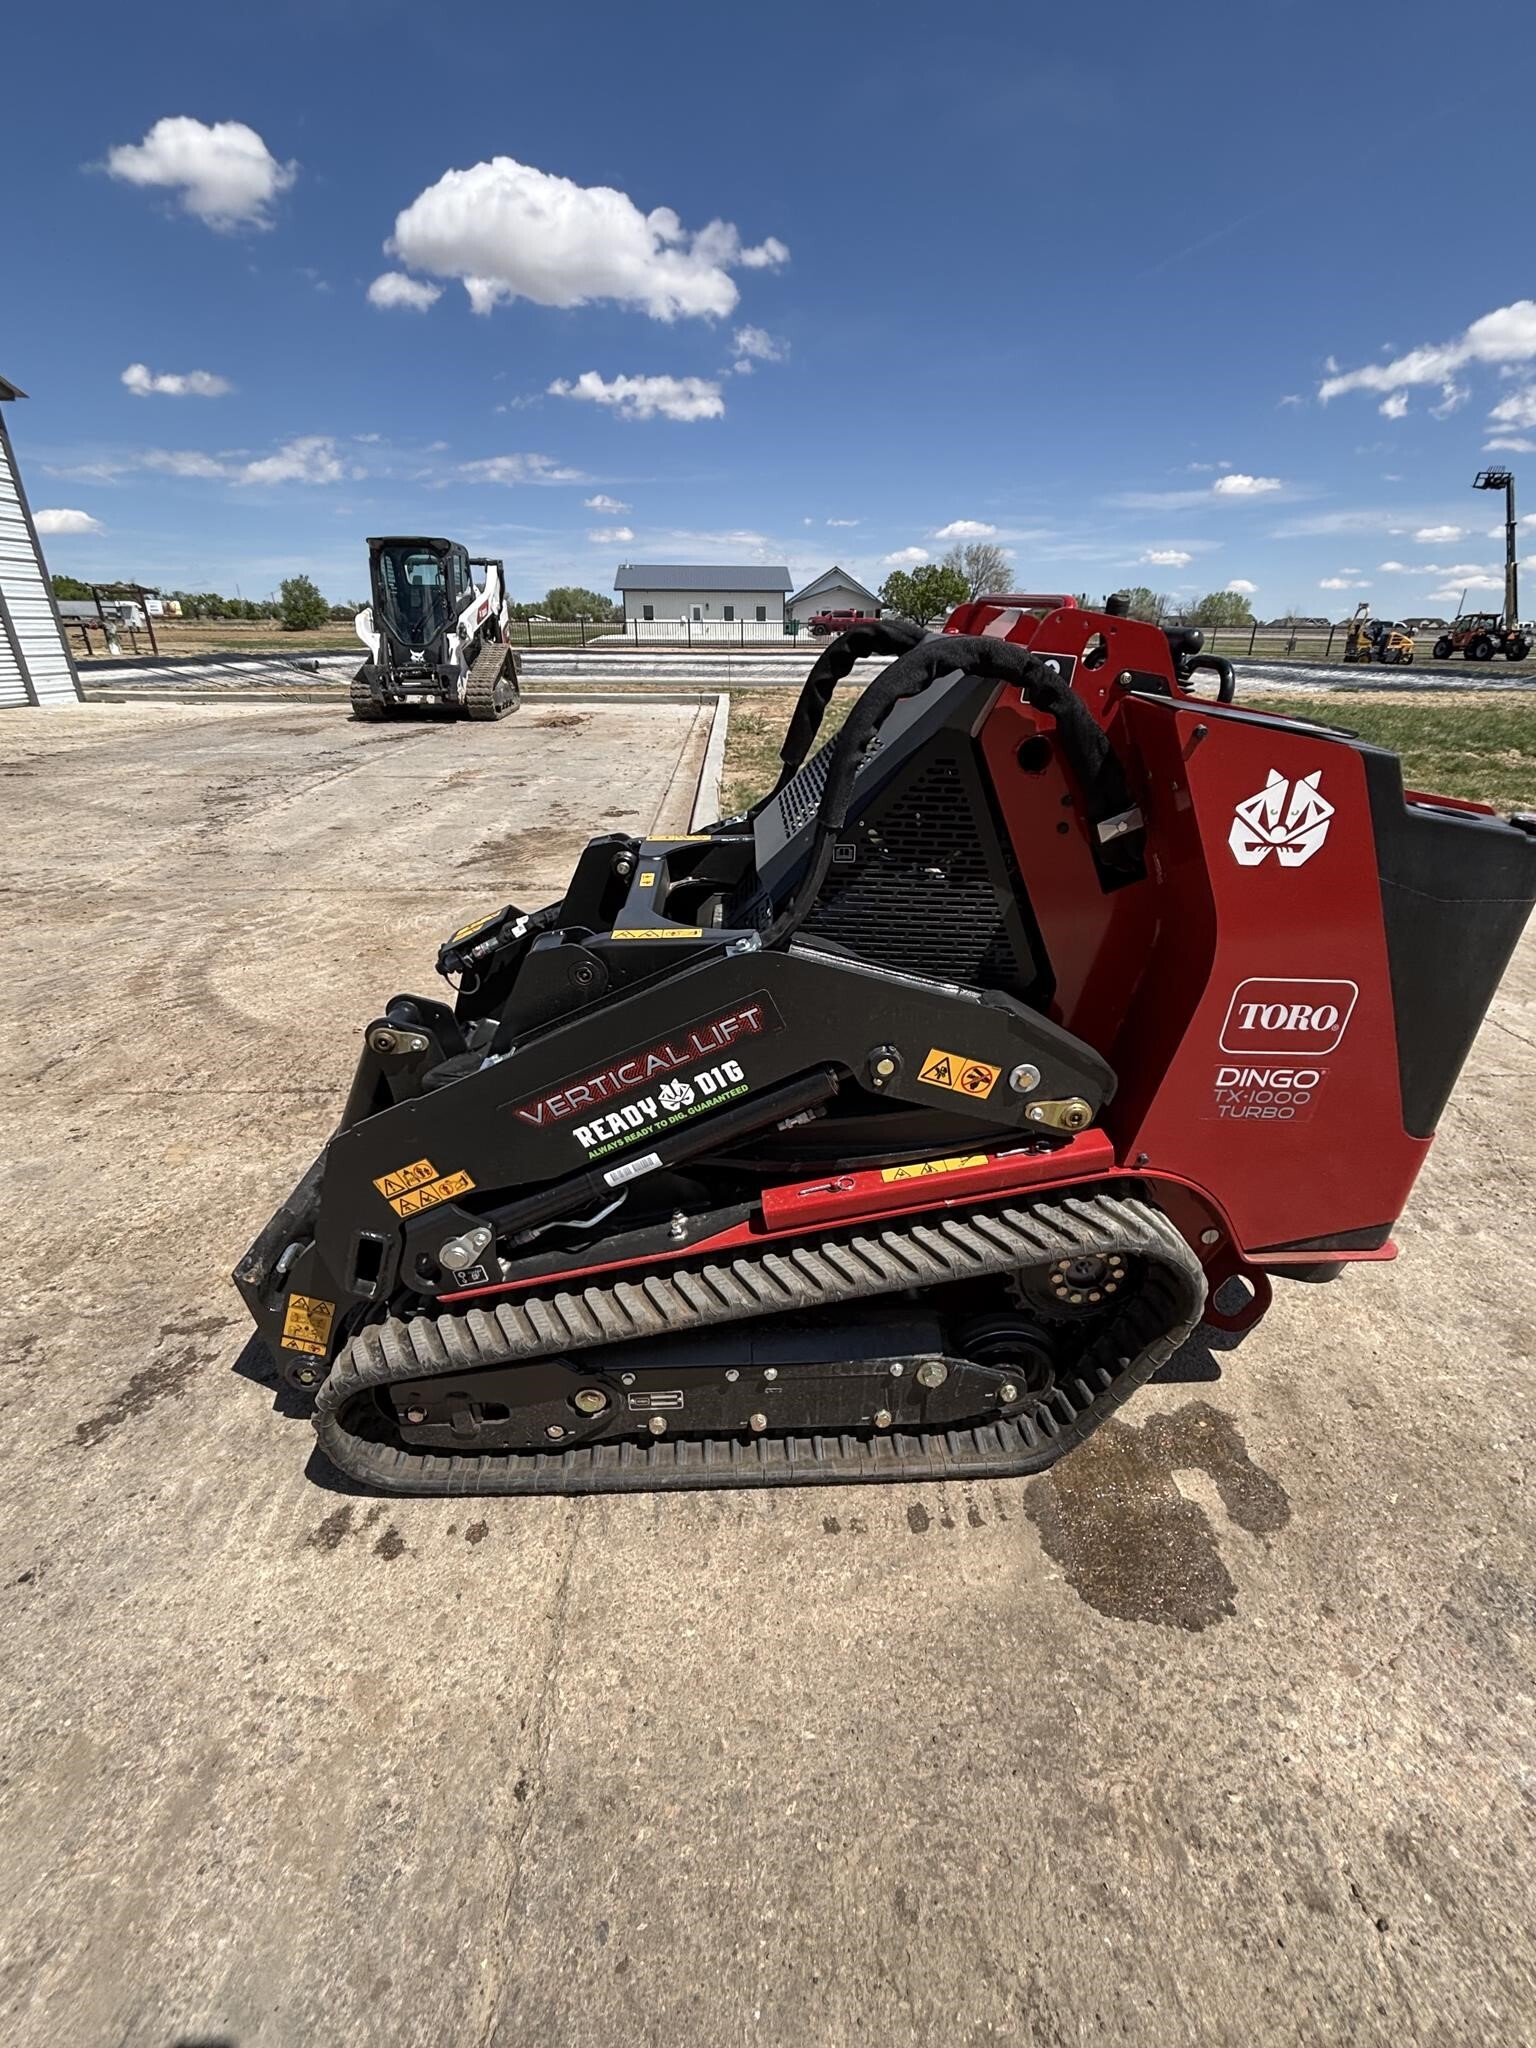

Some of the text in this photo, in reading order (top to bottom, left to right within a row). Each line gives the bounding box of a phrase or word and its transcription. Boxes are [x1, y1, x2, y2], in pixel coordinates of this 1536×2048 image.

[1238, 1003, 1339, 1031] TORO
[519, 1007, 759, 1124] VERTICAL LIFT
[1215, 1067, 1320, 1089] DINGO
[573, 1060, 745, 1149] READY DIG
[588, 1084, 749, 1160] ALWAYS READY TO DIG. GUARANTEED
[1219, 1105, 1295, 1119] TURBO
